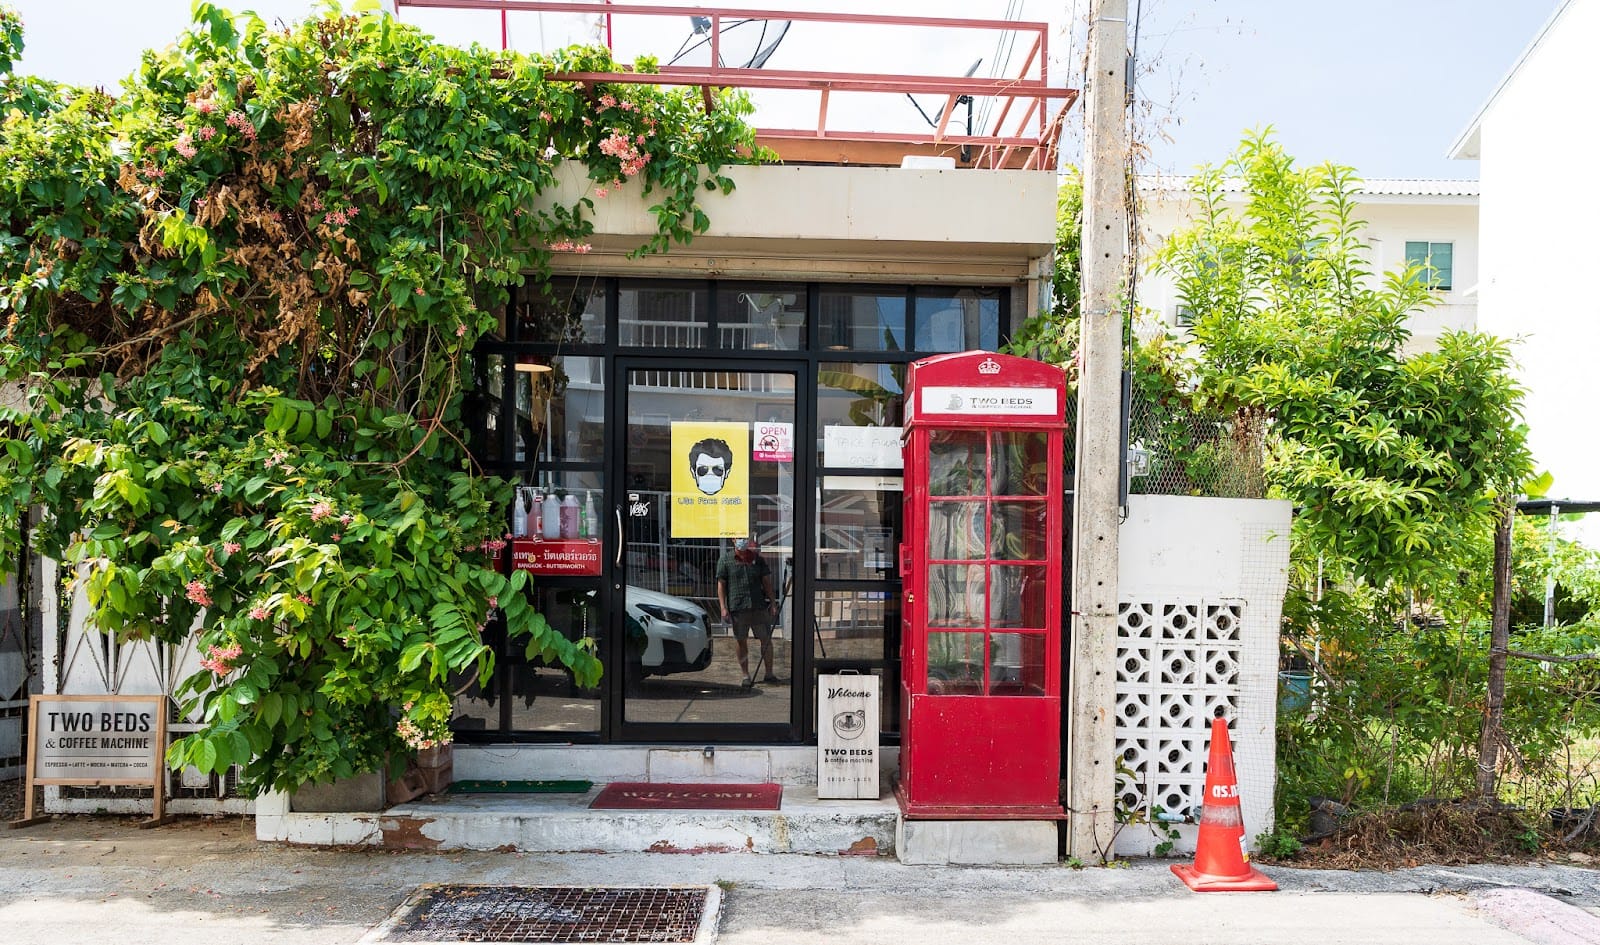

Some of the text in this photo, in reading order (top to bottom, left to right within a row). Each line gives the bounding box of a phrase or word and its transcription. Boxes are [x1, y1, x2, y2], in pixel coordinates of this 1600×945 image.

[969, 397, 998, 405] TWO
[760, 426, 787, 435] OPEN
[827, 687, 871, 699] Welcome
[48, 712, 150, 732] TWO BEDS
[45, 737, 149, 749] & COFFEE MACHINE
[824, 748, 847, 756] TWO
